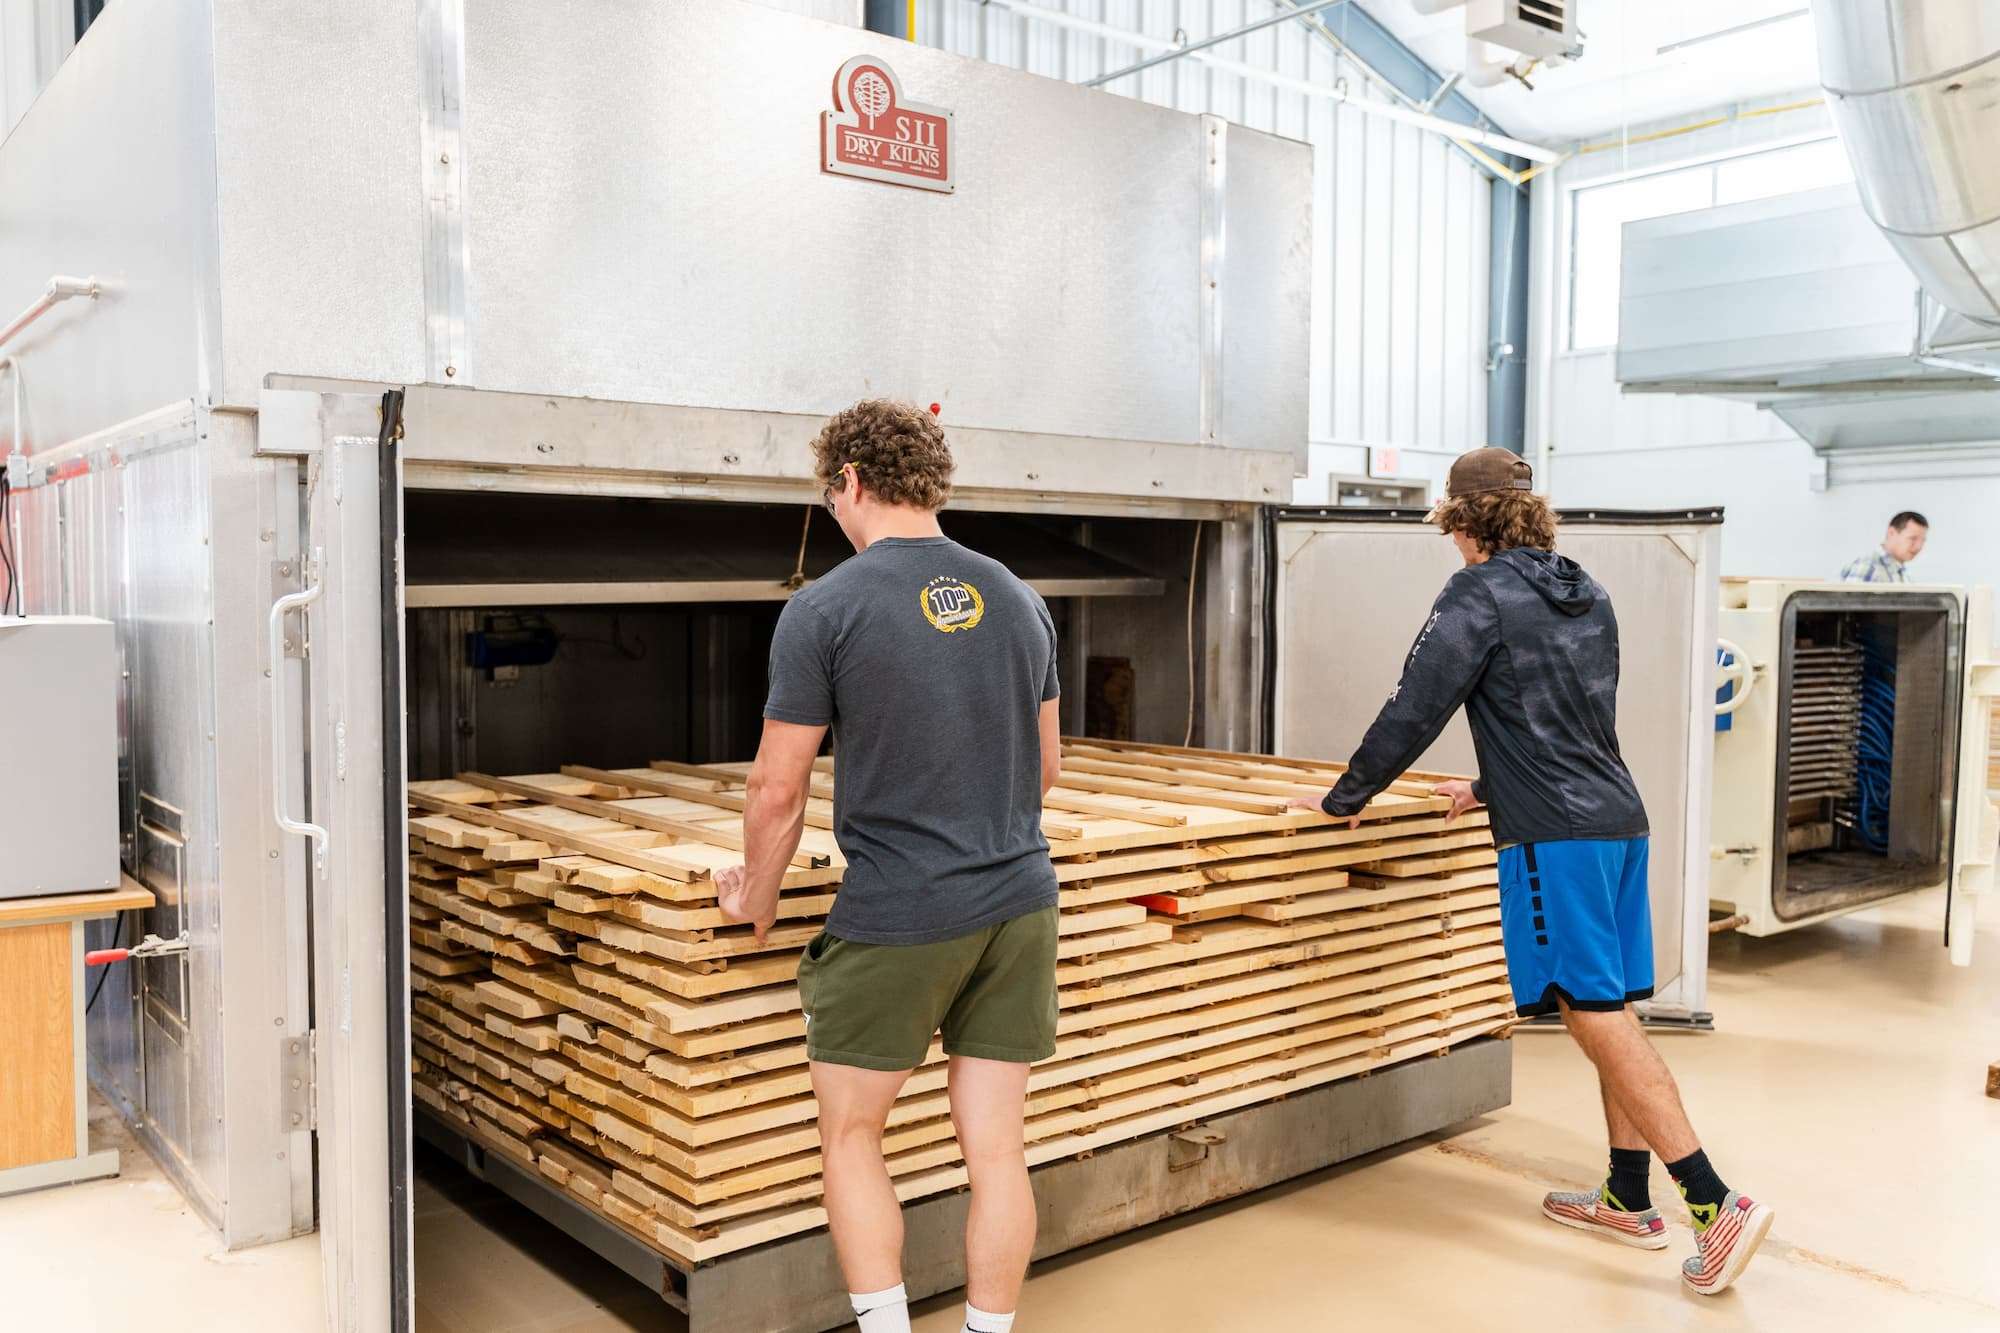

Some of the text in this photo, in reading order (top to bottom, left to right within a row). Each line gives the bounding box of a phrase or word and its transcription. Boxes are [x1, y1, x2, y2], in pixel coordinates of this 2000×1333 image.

[895, 116, 937, 148] SII
[844, 135, 883, 157] DRY
[889, 145, 940, 168] KILNS
[929, 586, 970, 615] 10th
